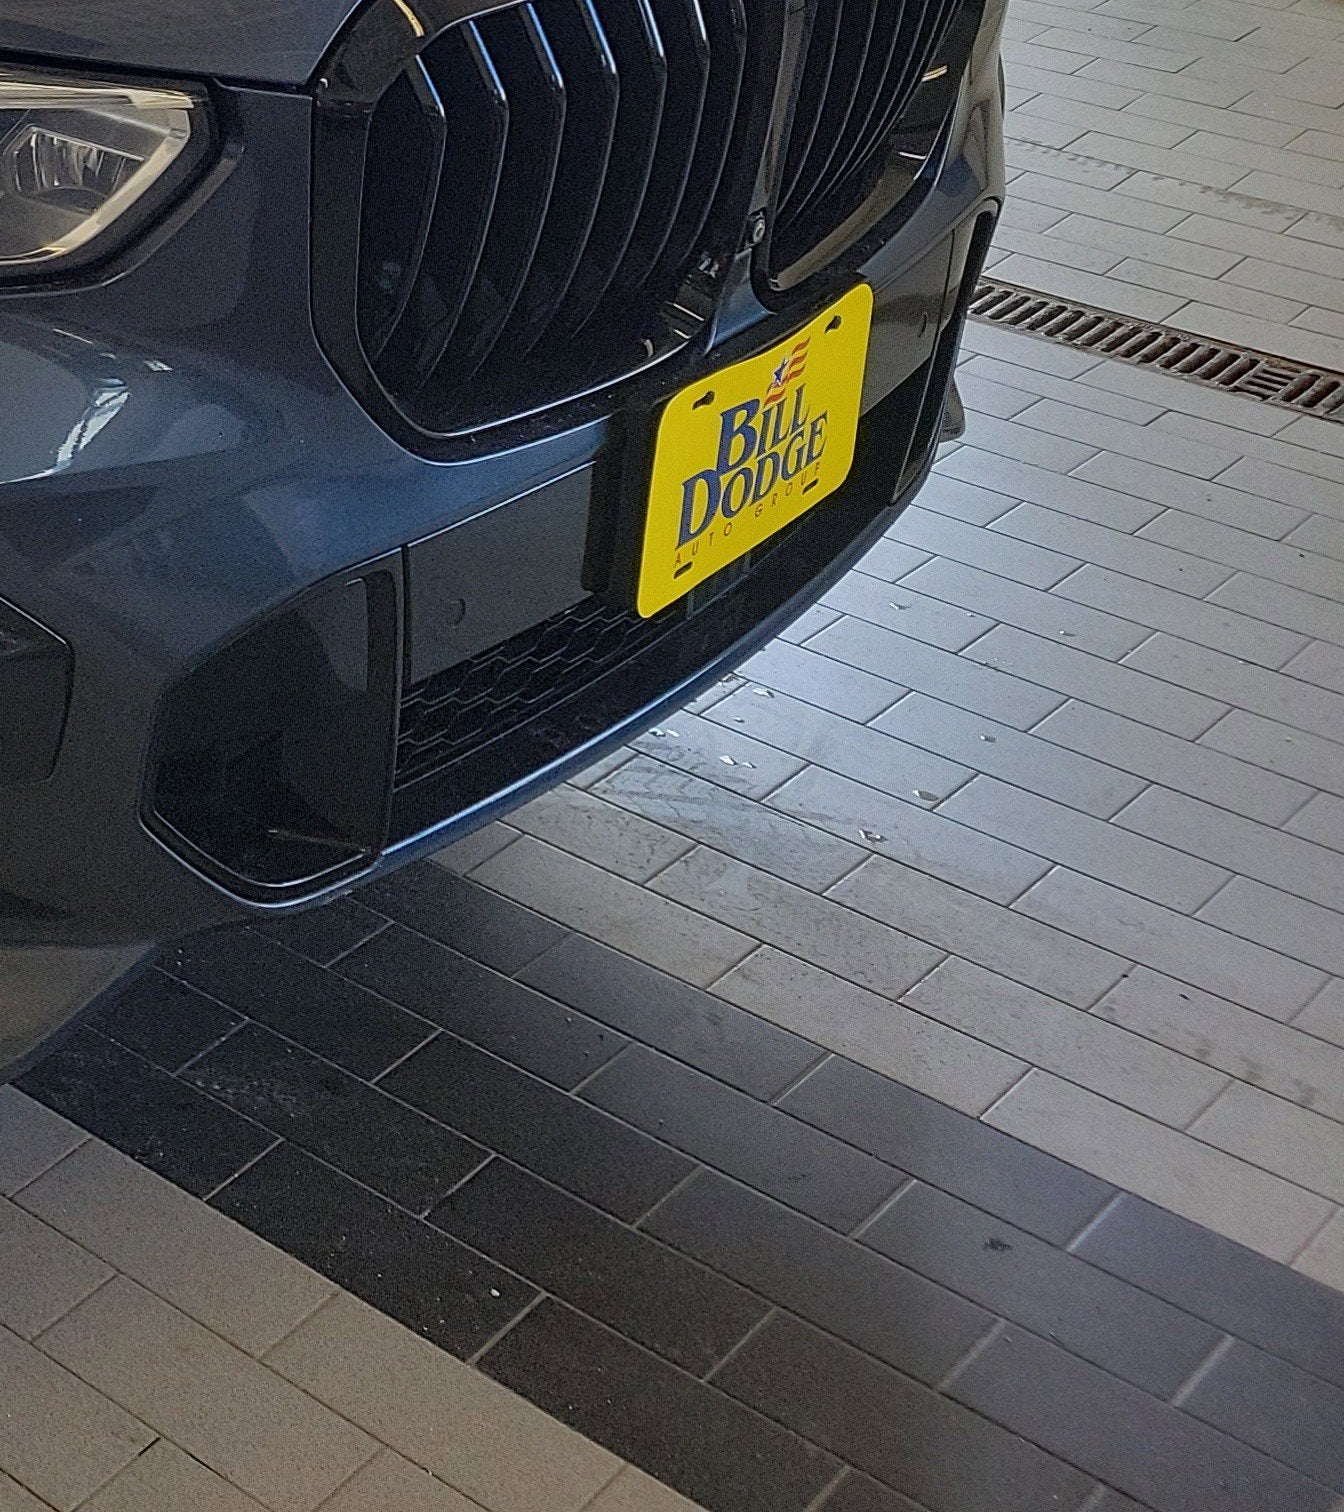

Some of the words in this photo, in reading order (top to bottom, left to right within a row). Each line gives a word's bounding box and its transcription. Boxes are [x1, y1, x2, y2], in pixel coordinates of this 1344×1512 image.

[673, 521, 733, 569] AUTO
[754, 461, 820, 519] GROUP
[675, 410, 828, 551] DODGE
